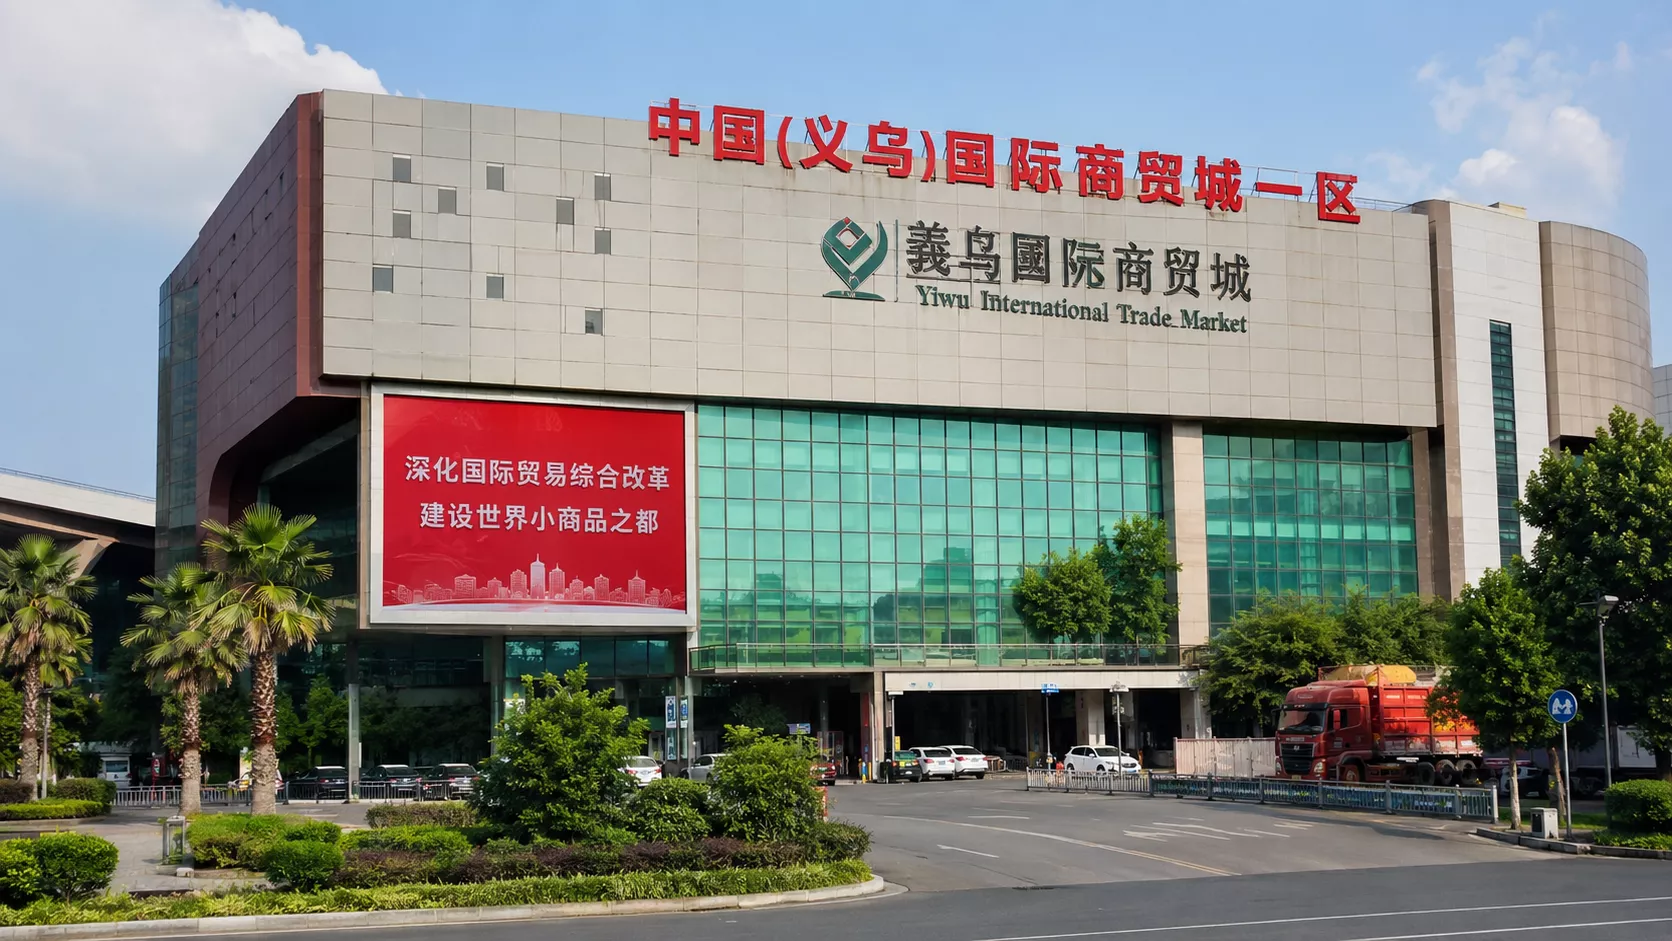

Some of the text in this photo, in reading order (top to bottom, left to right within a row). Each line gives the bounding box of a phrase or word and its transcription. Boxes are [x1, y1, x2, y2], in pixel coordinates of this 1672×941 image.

[648, 97, 1360, 223] 中国(义乌)国际商贸城一区
[915, 285, 1247, 333] Yiwu International Trade Market
[405, 455, 670, 491] 深化国际贸易综合改革
[420, 502, 659, 534] 建设世界小商品之都
